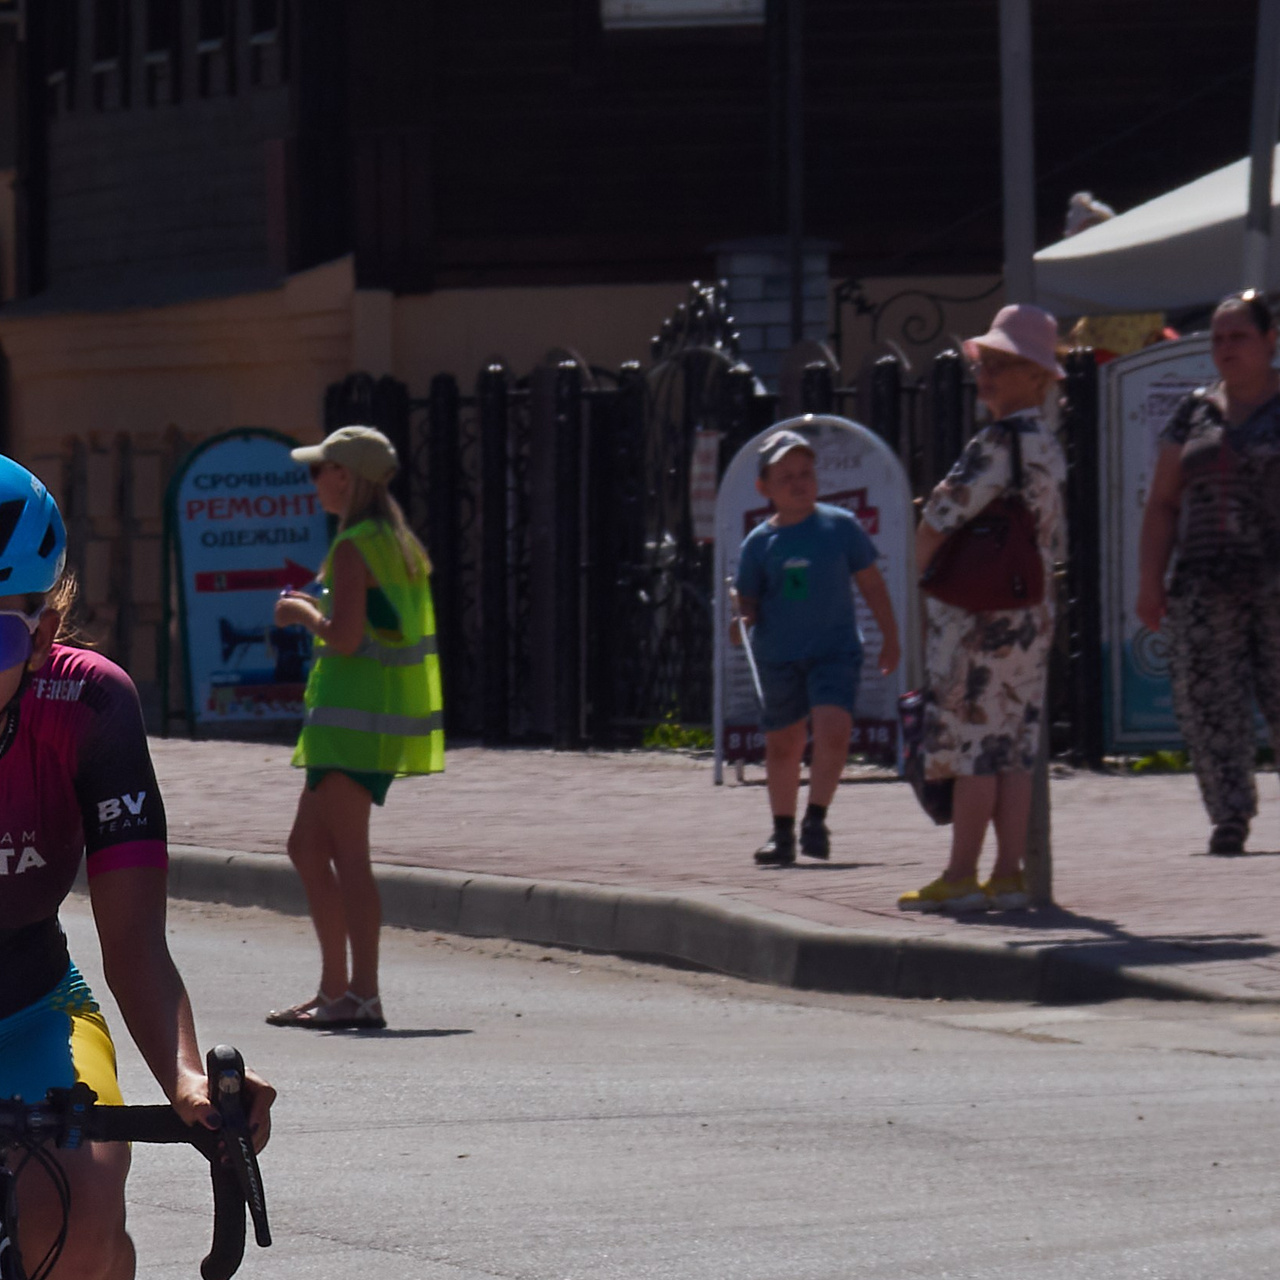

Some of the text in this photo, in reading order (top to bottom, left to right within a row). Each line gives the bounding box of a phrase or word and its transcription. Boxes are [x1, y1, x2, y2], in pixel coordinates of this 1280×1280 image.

[185, 494, 318, 521] РЕМОНТ
[201, 527, 310, 549] ОДЕЖДЫ
[97, 791, 147, 822] BV
[98, 816, 148, 834] TEAM
